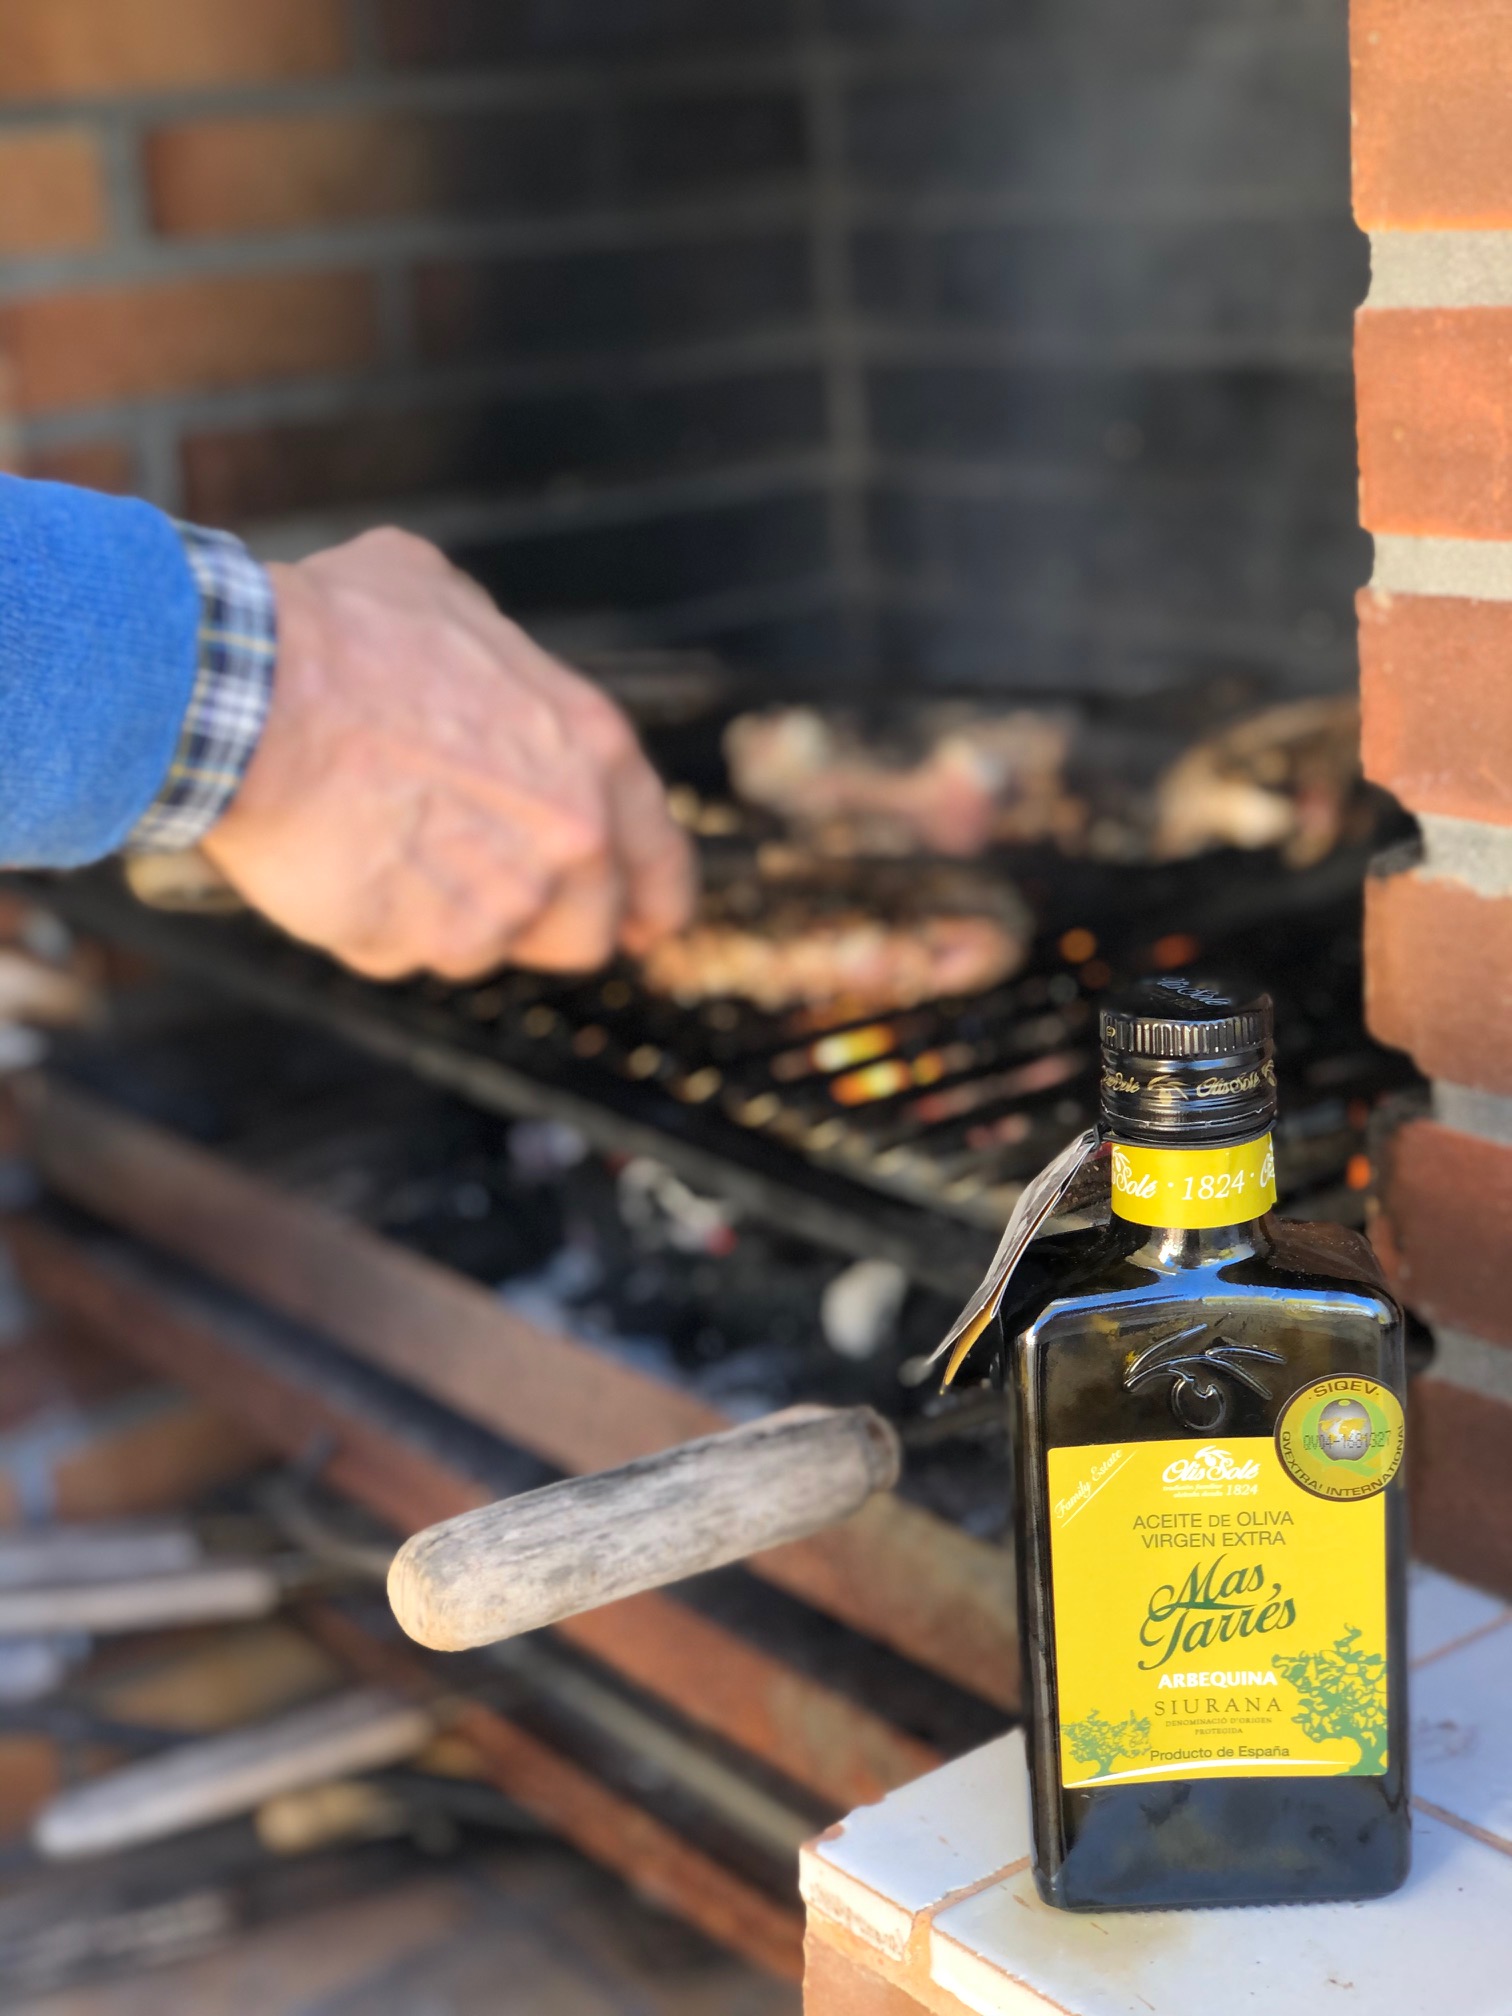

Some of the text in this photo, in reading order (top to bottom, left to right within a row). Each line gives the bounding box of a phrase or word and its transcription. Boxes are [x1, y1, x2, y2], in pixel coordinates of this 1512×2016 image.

[1181, 1169, 1246, 1201] 1824
[1313, 1380, 1378, 1397] SIQEV
[1054, 1449, 1122, 1519] Family Estate
[1226, 1484, 1259, 1496] 1824
[1133, 1510, 1295, 1530] ACEITE DE OLIVA
[1141, 1530, 1287, 1549] VIRGEN EXTRA
[1148, 1553, 1265, 1622] Mas
[1158, 1670, 1279, 1689] ARBEQUINA
[1154, 1697, 1283, 1716] SIURANA
[1150, 1745, 1290, 1762] Producto de España
